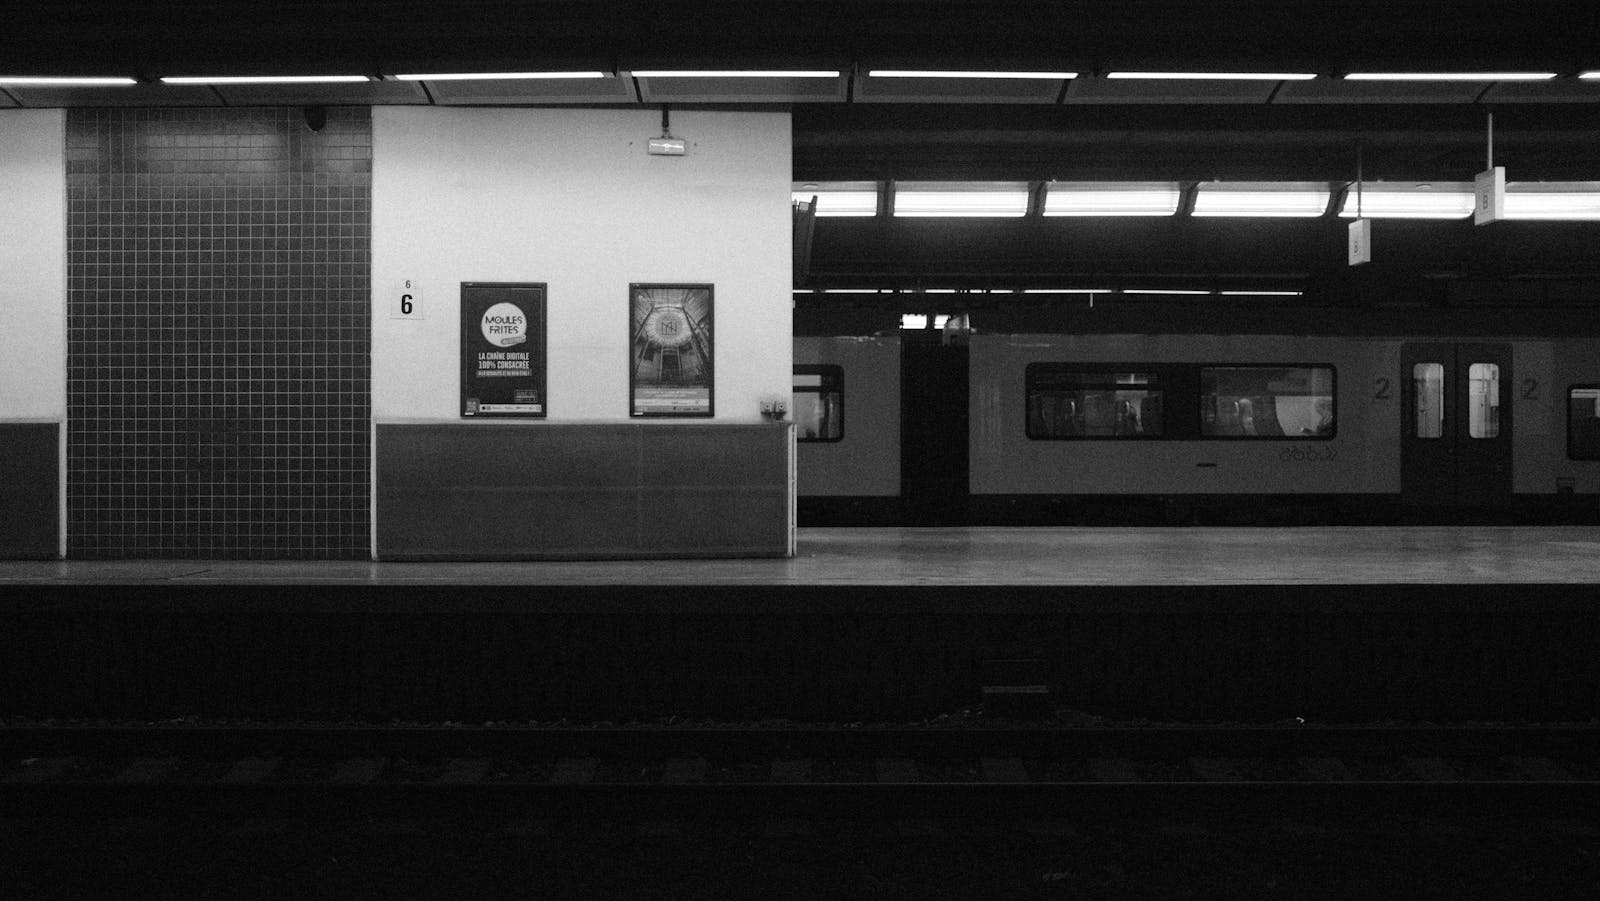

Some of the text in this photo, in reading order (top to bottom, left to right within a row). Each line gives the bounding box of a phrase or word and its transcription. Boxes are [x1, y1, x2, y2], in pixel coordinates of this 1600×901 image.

[405, 280, 411, 289] 6
[401, 294, 412, 314] 6
[485, 316, 523, 325] MOULES
[490, 326, 519, 335] FRITES
[478, 352, 486, 360] LA
[506, 352, 530, 360] DIGITALE
[478, 361, 496, 369] 100%
[1375, 378, 1390, 400] 2
[1524, 379, 1539, 400] 2
